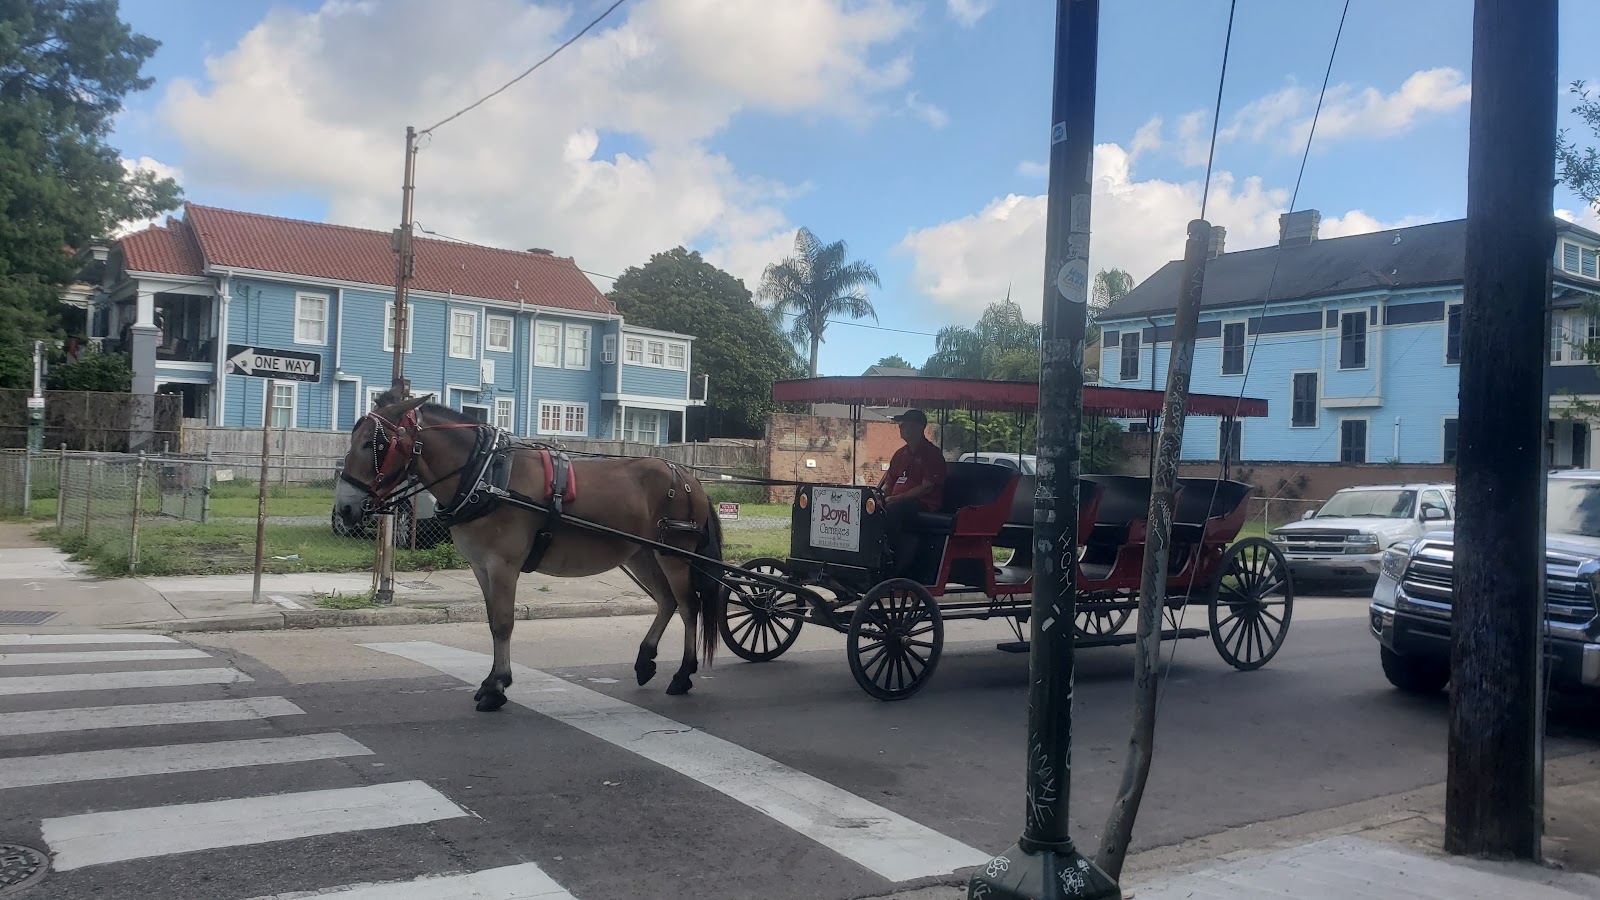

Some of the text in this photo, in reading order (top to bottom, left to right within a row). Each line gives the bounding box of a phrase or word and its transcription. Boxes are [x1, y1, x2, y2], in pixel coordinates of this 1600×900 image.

[254, 356, 311, 373] ONE WAY
[820, 503, 851, 526] Royal
[819, 523, 850, 539] Carriages
